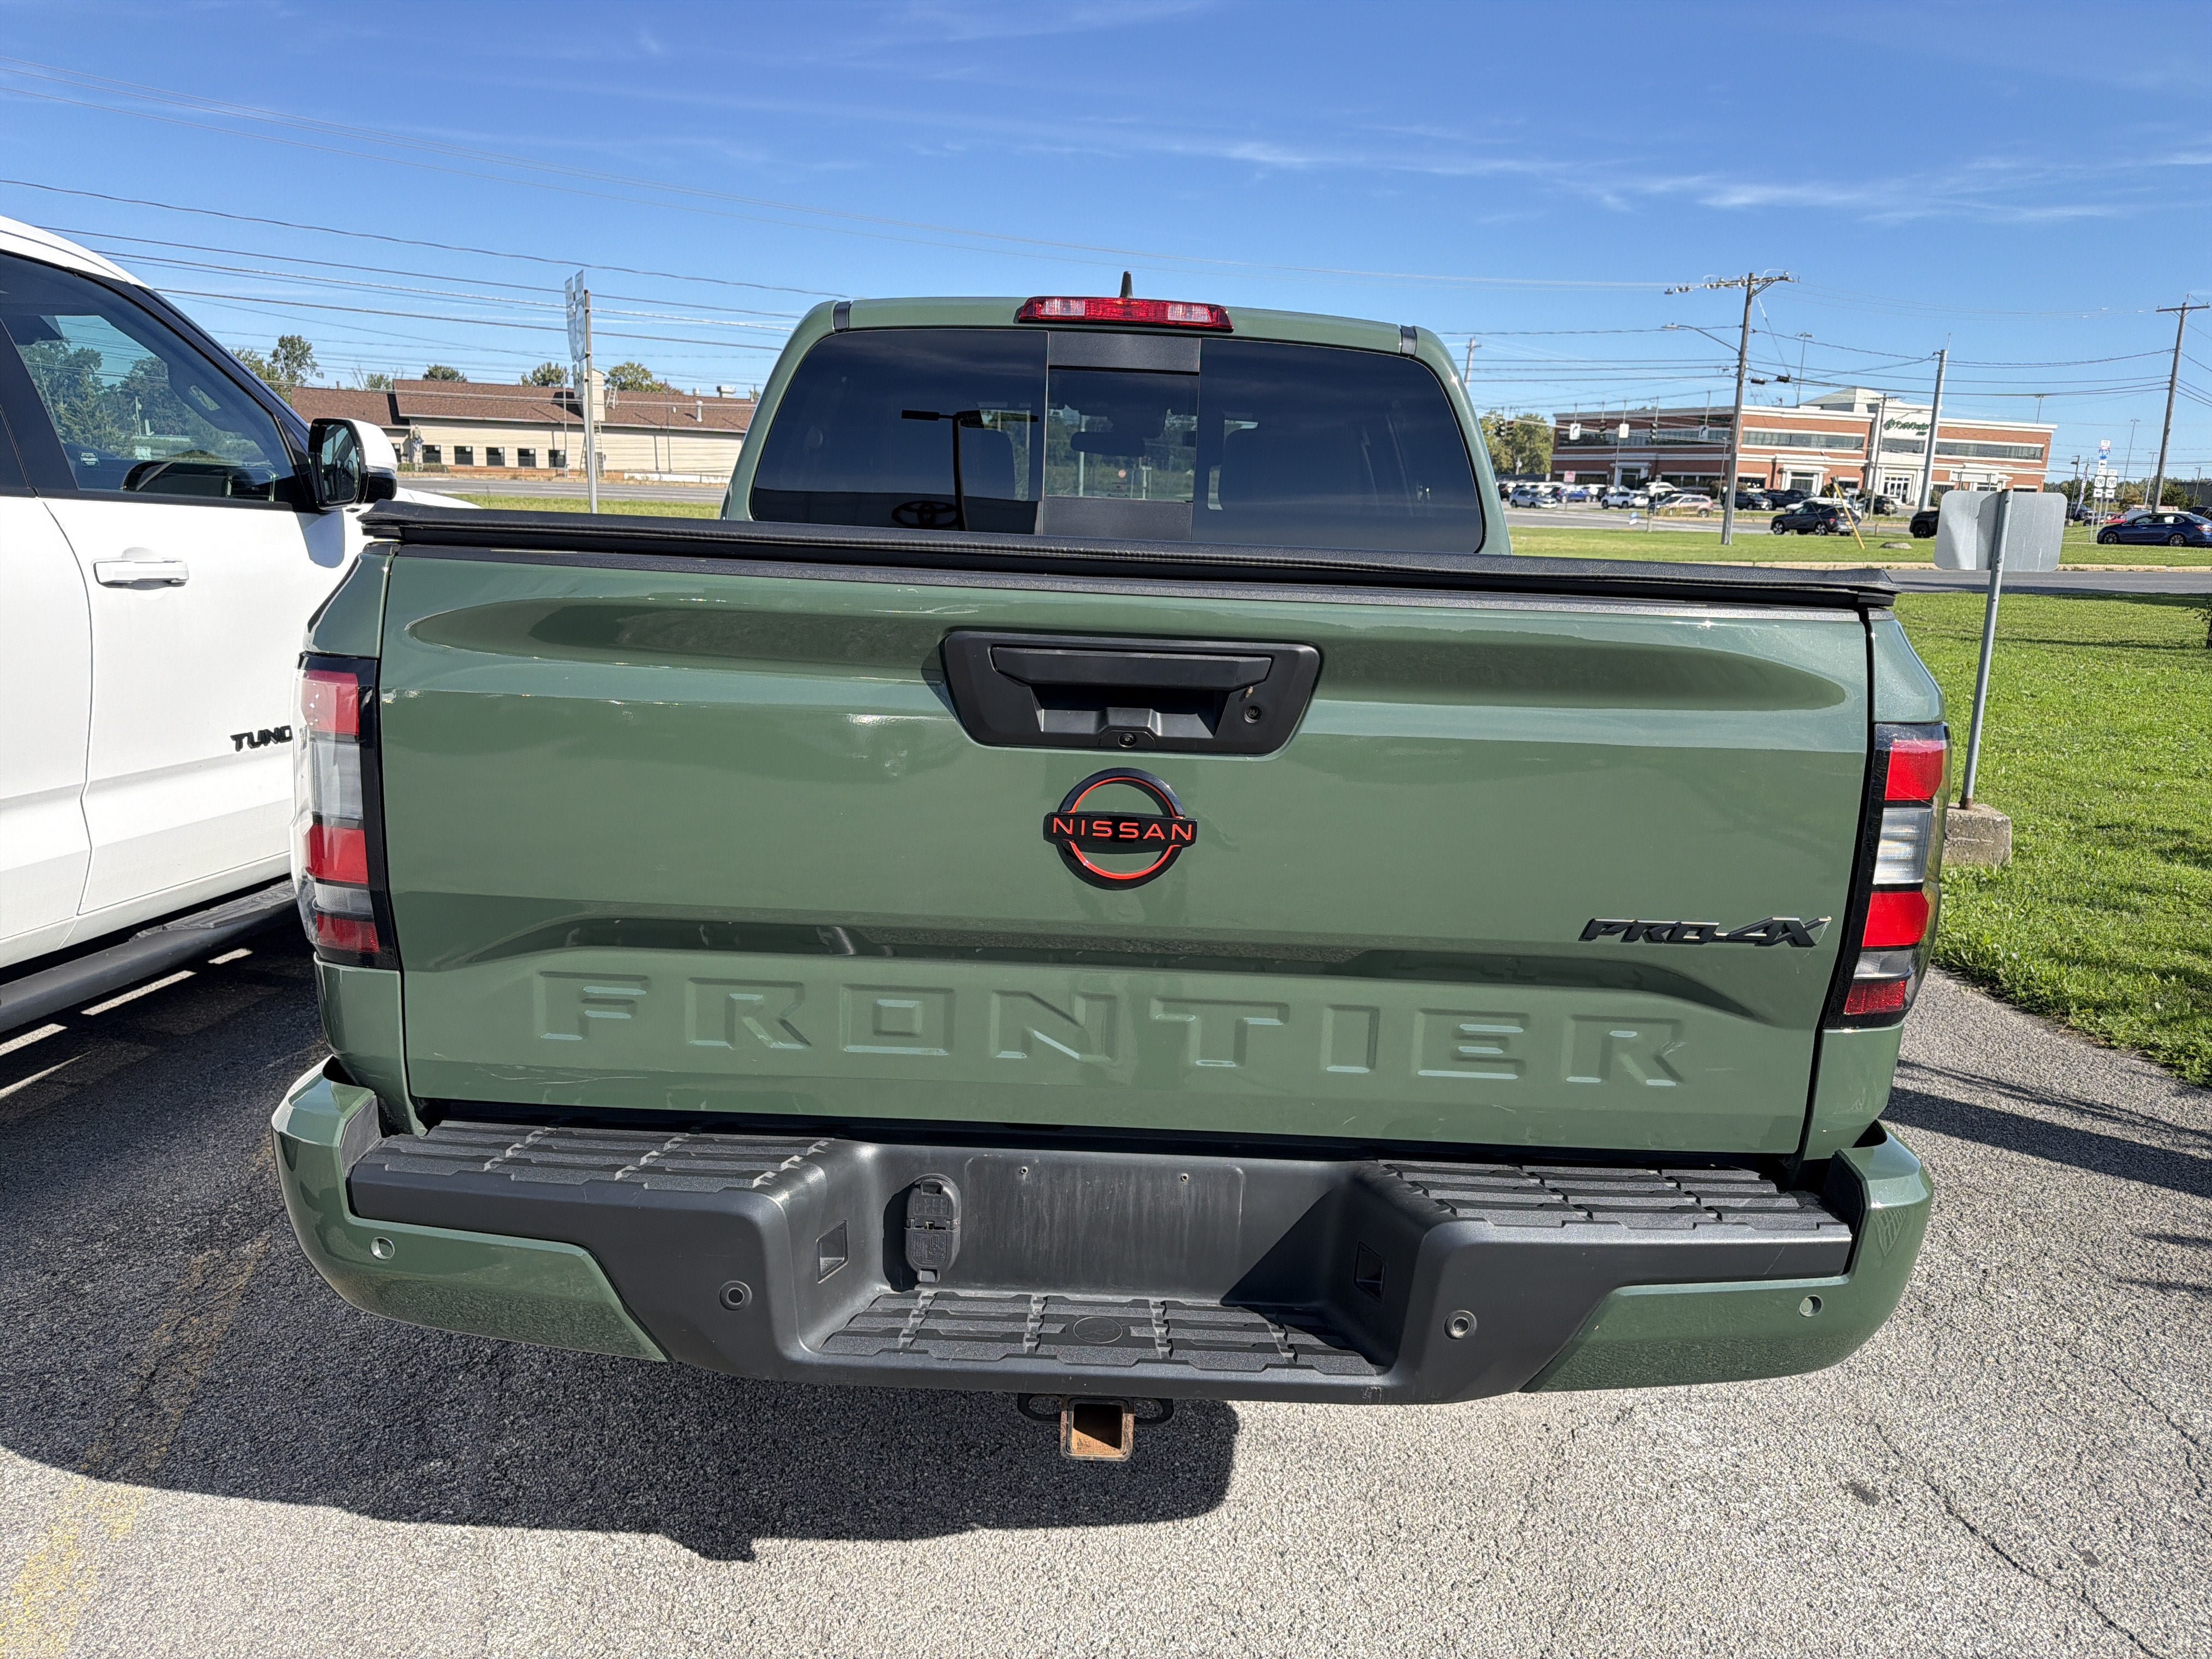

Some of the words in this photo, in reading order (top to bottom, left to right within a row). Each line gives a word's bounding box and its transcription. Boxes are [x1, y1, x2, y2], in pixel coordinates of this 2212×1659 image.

[1053, 817, 1193, 840] NISSAN
[1578, 916, 1832, 947] PRO-4X
[533, 970, 1684, 1086] FRONTIER
